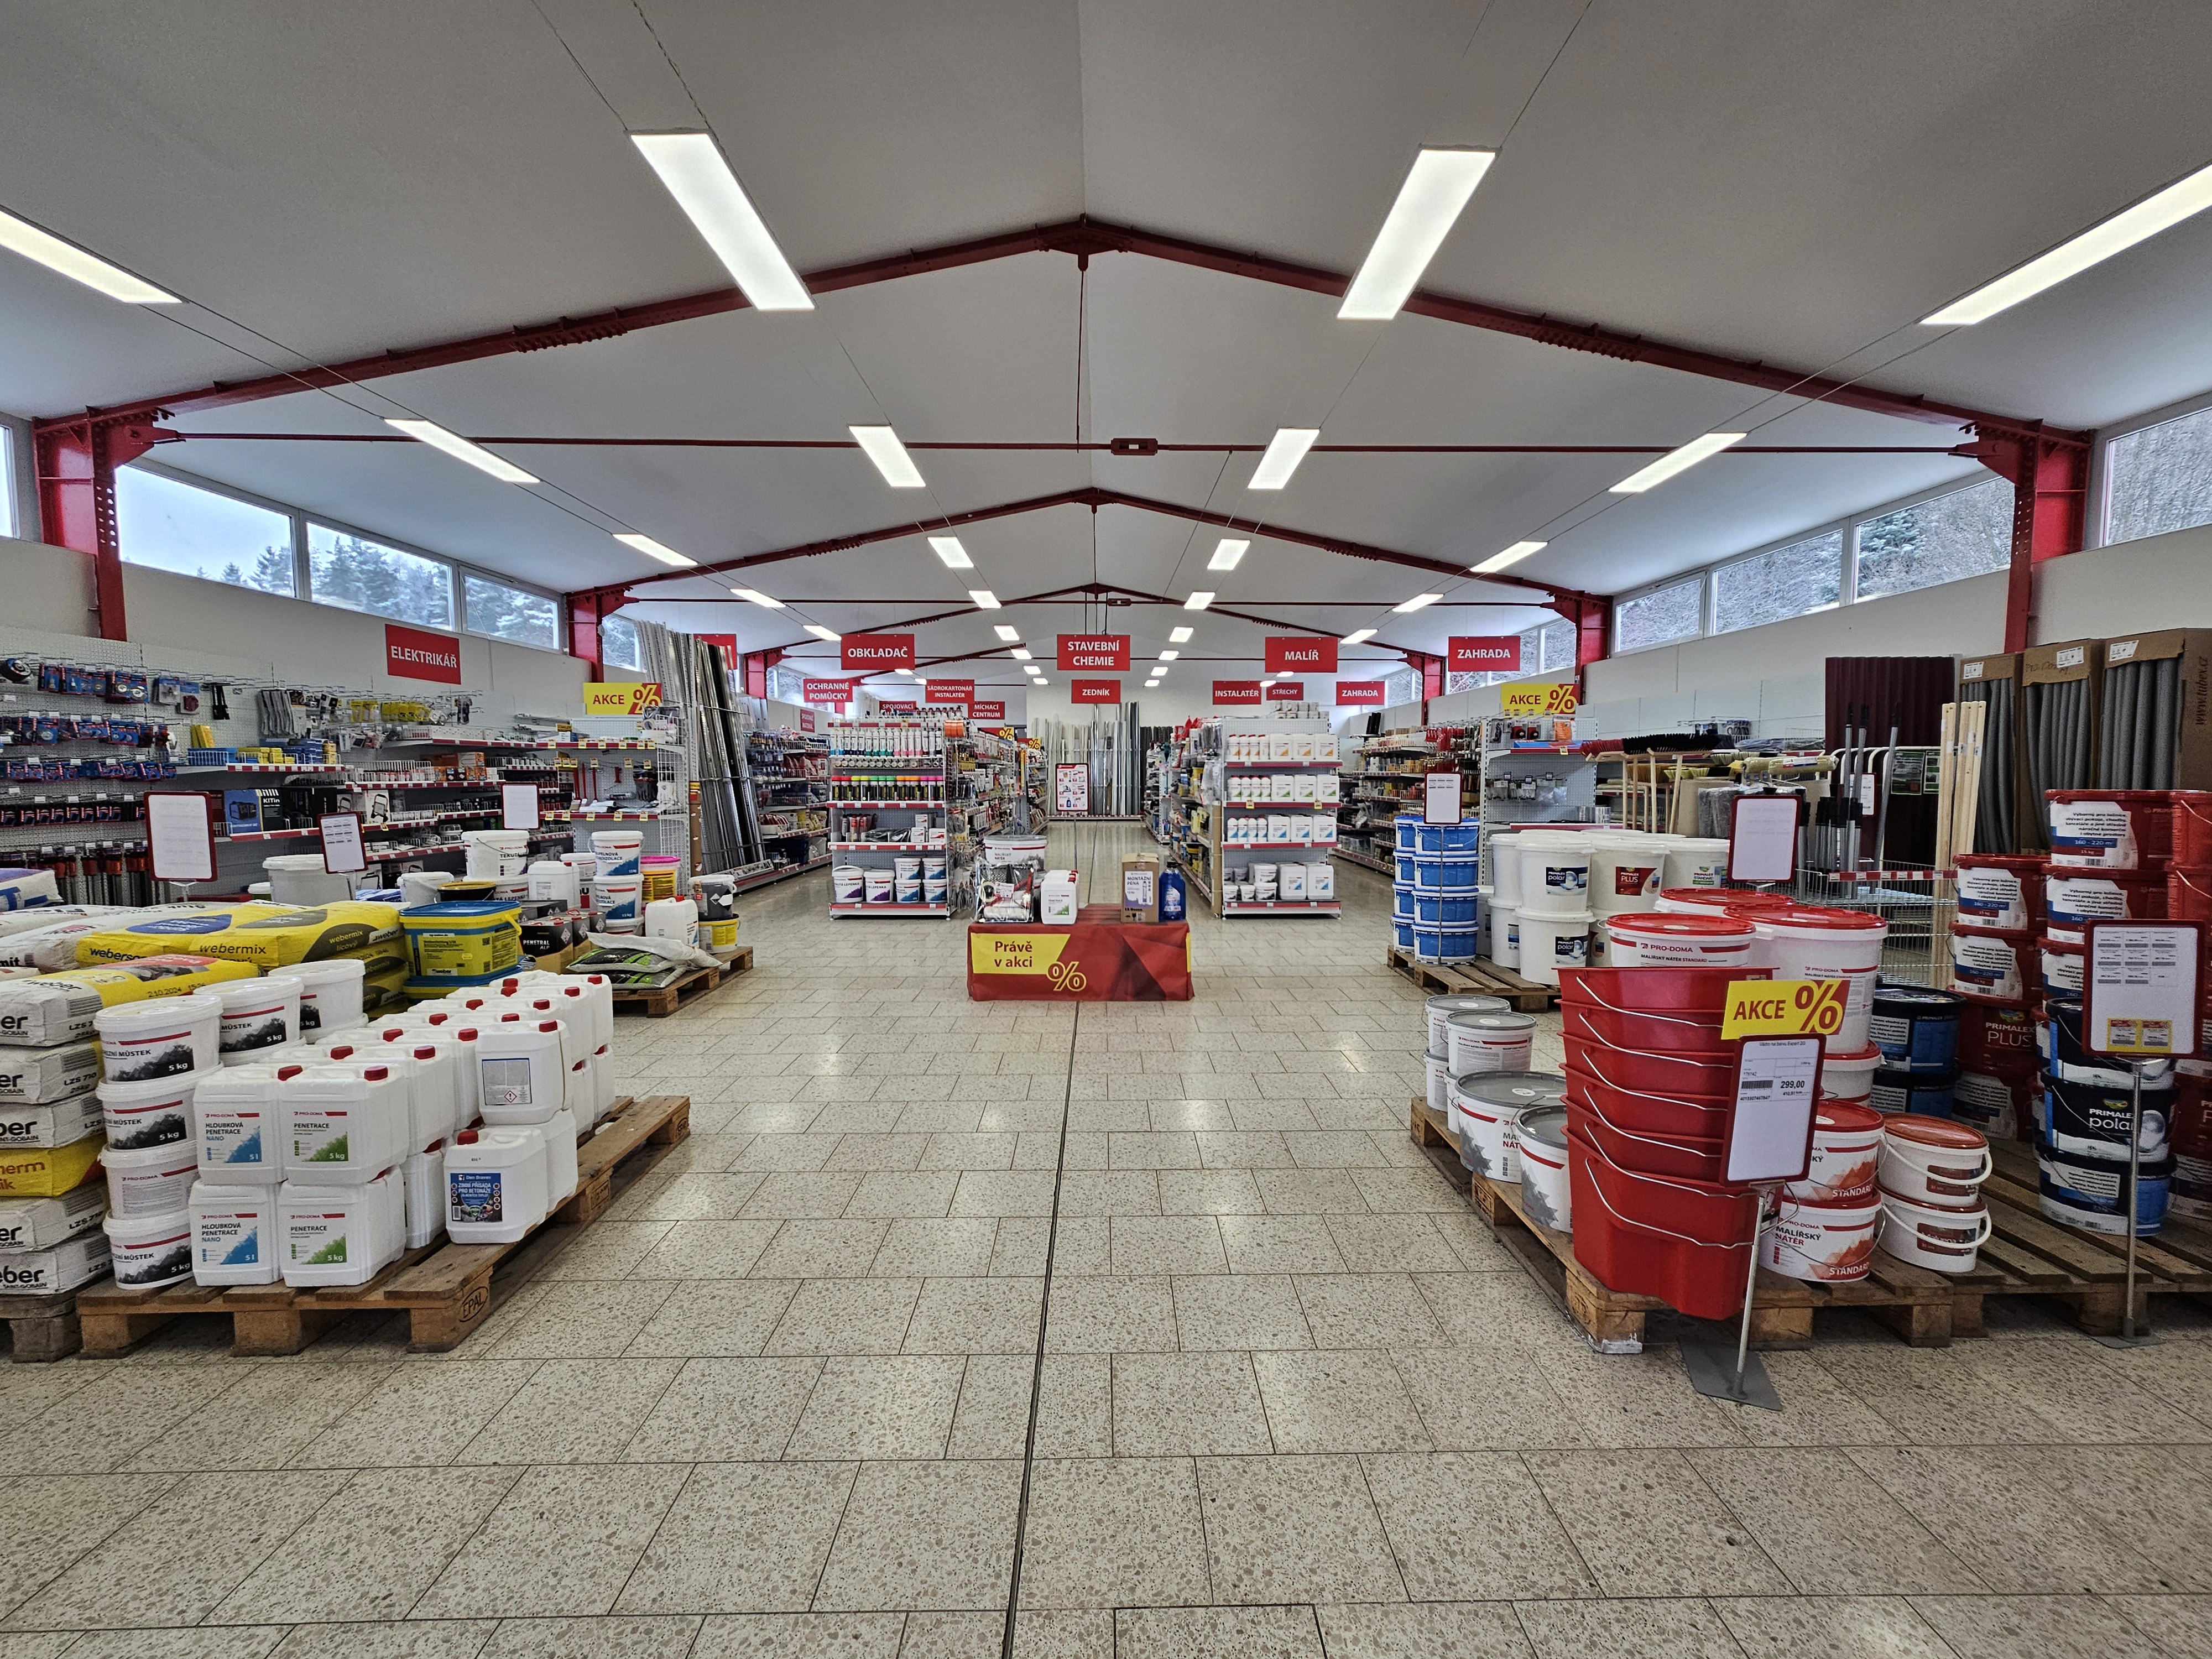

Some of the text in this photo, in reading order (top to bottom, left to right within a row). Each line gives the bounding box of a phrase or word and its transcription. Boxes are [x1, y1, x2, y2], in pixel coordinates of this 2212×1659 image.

[1068, 640, 1120, 651] STAVEBNÍ
[390, 645, 457, 668] ELEKTRIKÁŘ
[848, 646, 908, 658] OBKLADAČ
[1285, 649, 1319, 660] MALÍŘ
[1458, 649, 1511, 659] ZAHRADA
[1073, 656, 1114, 666] CHEMIE
[807, 681, 849, 690] OCHRANNÉ
[2196, 656, 2208, 726] www.tubex.cz
[593, 695, 624, 705] AKCE
[810, 691, 847, 700] POMŮCKY
[1510, 695, 1541, 705] AKCE
[328, 930, 363, 944] webermix
[377, 929, 399, 940] weber
[199, 943, 267, 954] webermix
[995, 941, 1032, 952] Právě
[995, 956, 1032, 967] v akci
[1733, 1000, 1786, 1020] AKCE
[1985, 1022, 2035, 1033] PRIMALEX
[1987, 1031, 2032, 1047] PLUS
[64, 1076, 81, 1086] LZS
[1780, 1081, 1805, 1089] 299,00
[2089, 1108, 2135, 1119] PRIMALE
[85, 1119, 102, 1129] LZS
[1503, 1140, 1520, 1149] NÁT
[336, 1152, 345, 1160] kg
[1775, 1225, 1822, 1241] MALÍŘSKÝ
[1775, 1233, 1804, 1245] NÁTĚR
[124, 1253, 154, 1261] MŮSTEK
[179, 1262, 191, 1271] kg
[462, 1290, 484, 1319] EPAL
